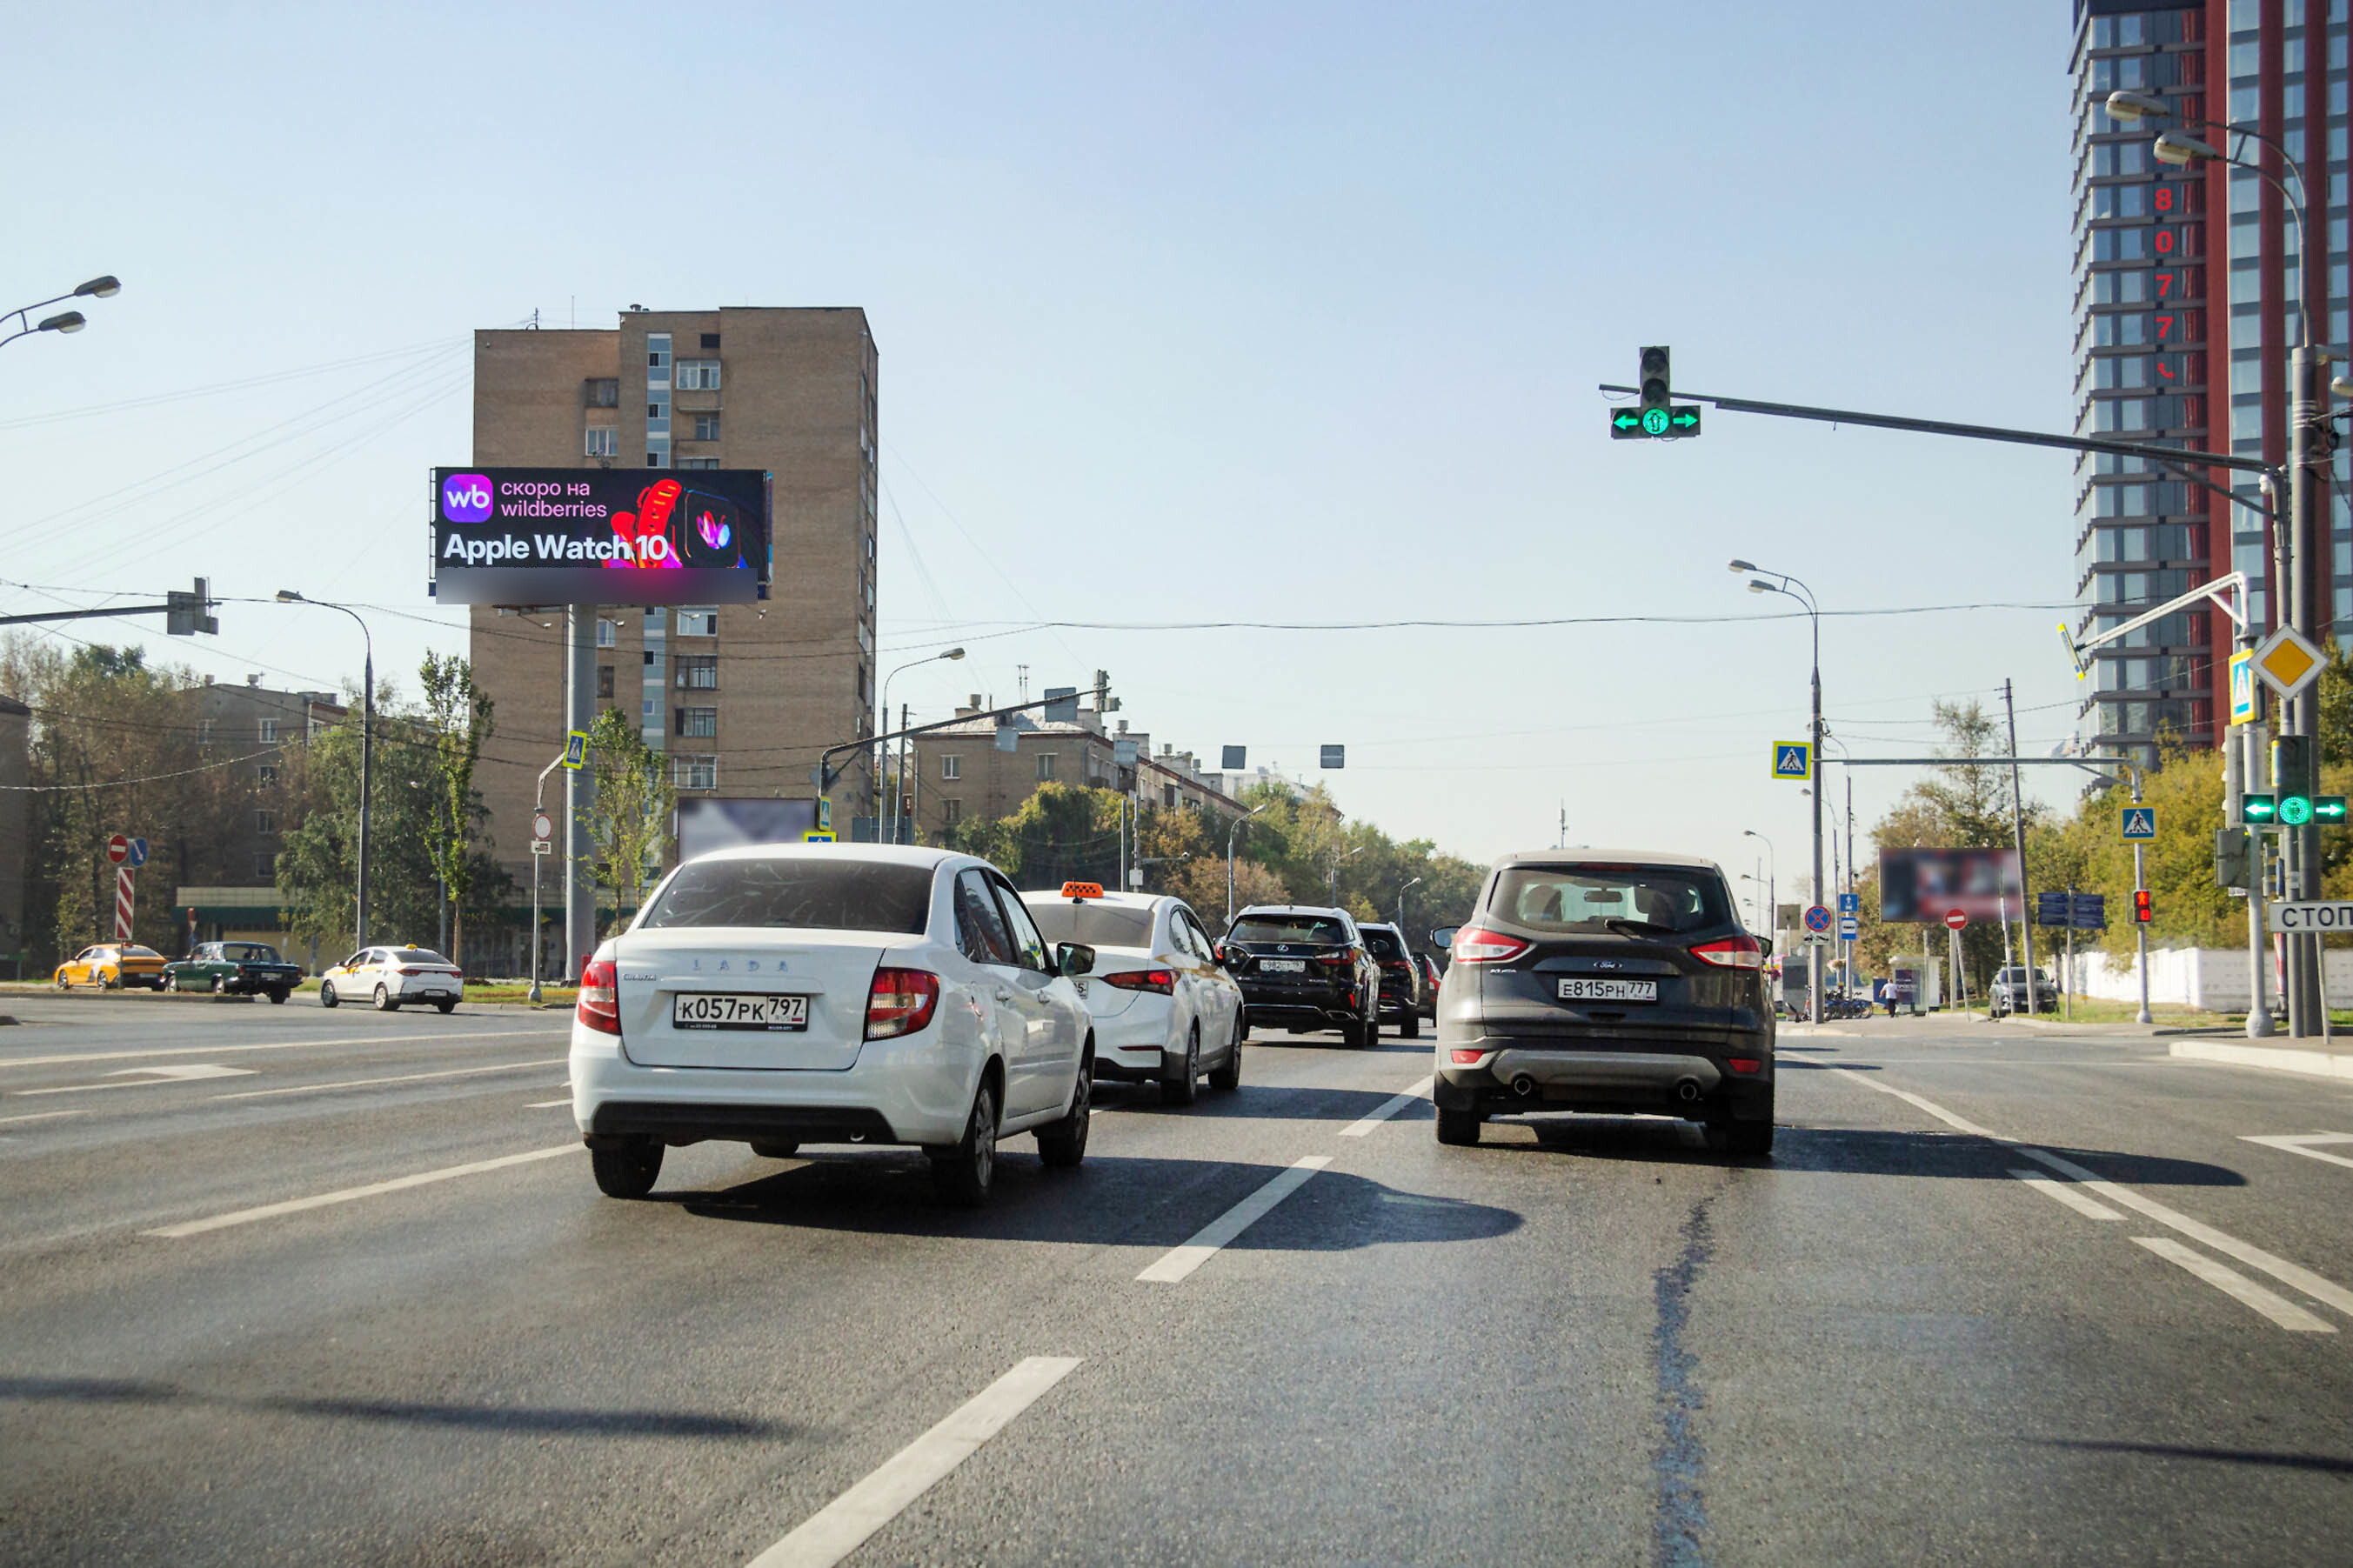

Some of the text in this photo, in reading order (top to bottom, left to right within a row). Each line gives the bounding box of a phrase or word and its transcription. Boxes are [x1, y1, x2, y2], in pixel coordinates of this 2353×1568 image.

[446, 484, 490, 509] wb
[501, 482, 590, 499] скоро на
[500, 499, 607, 517] wildberries
[443, 533, 669, 565] Apple Watch 10
[2282, 906, 2353, 927] СТОП
[692, 959, 788, 972] LADA
[1628, 982, 1653, 994] 777
[681, 998, 802, 1021] К057РК 797
